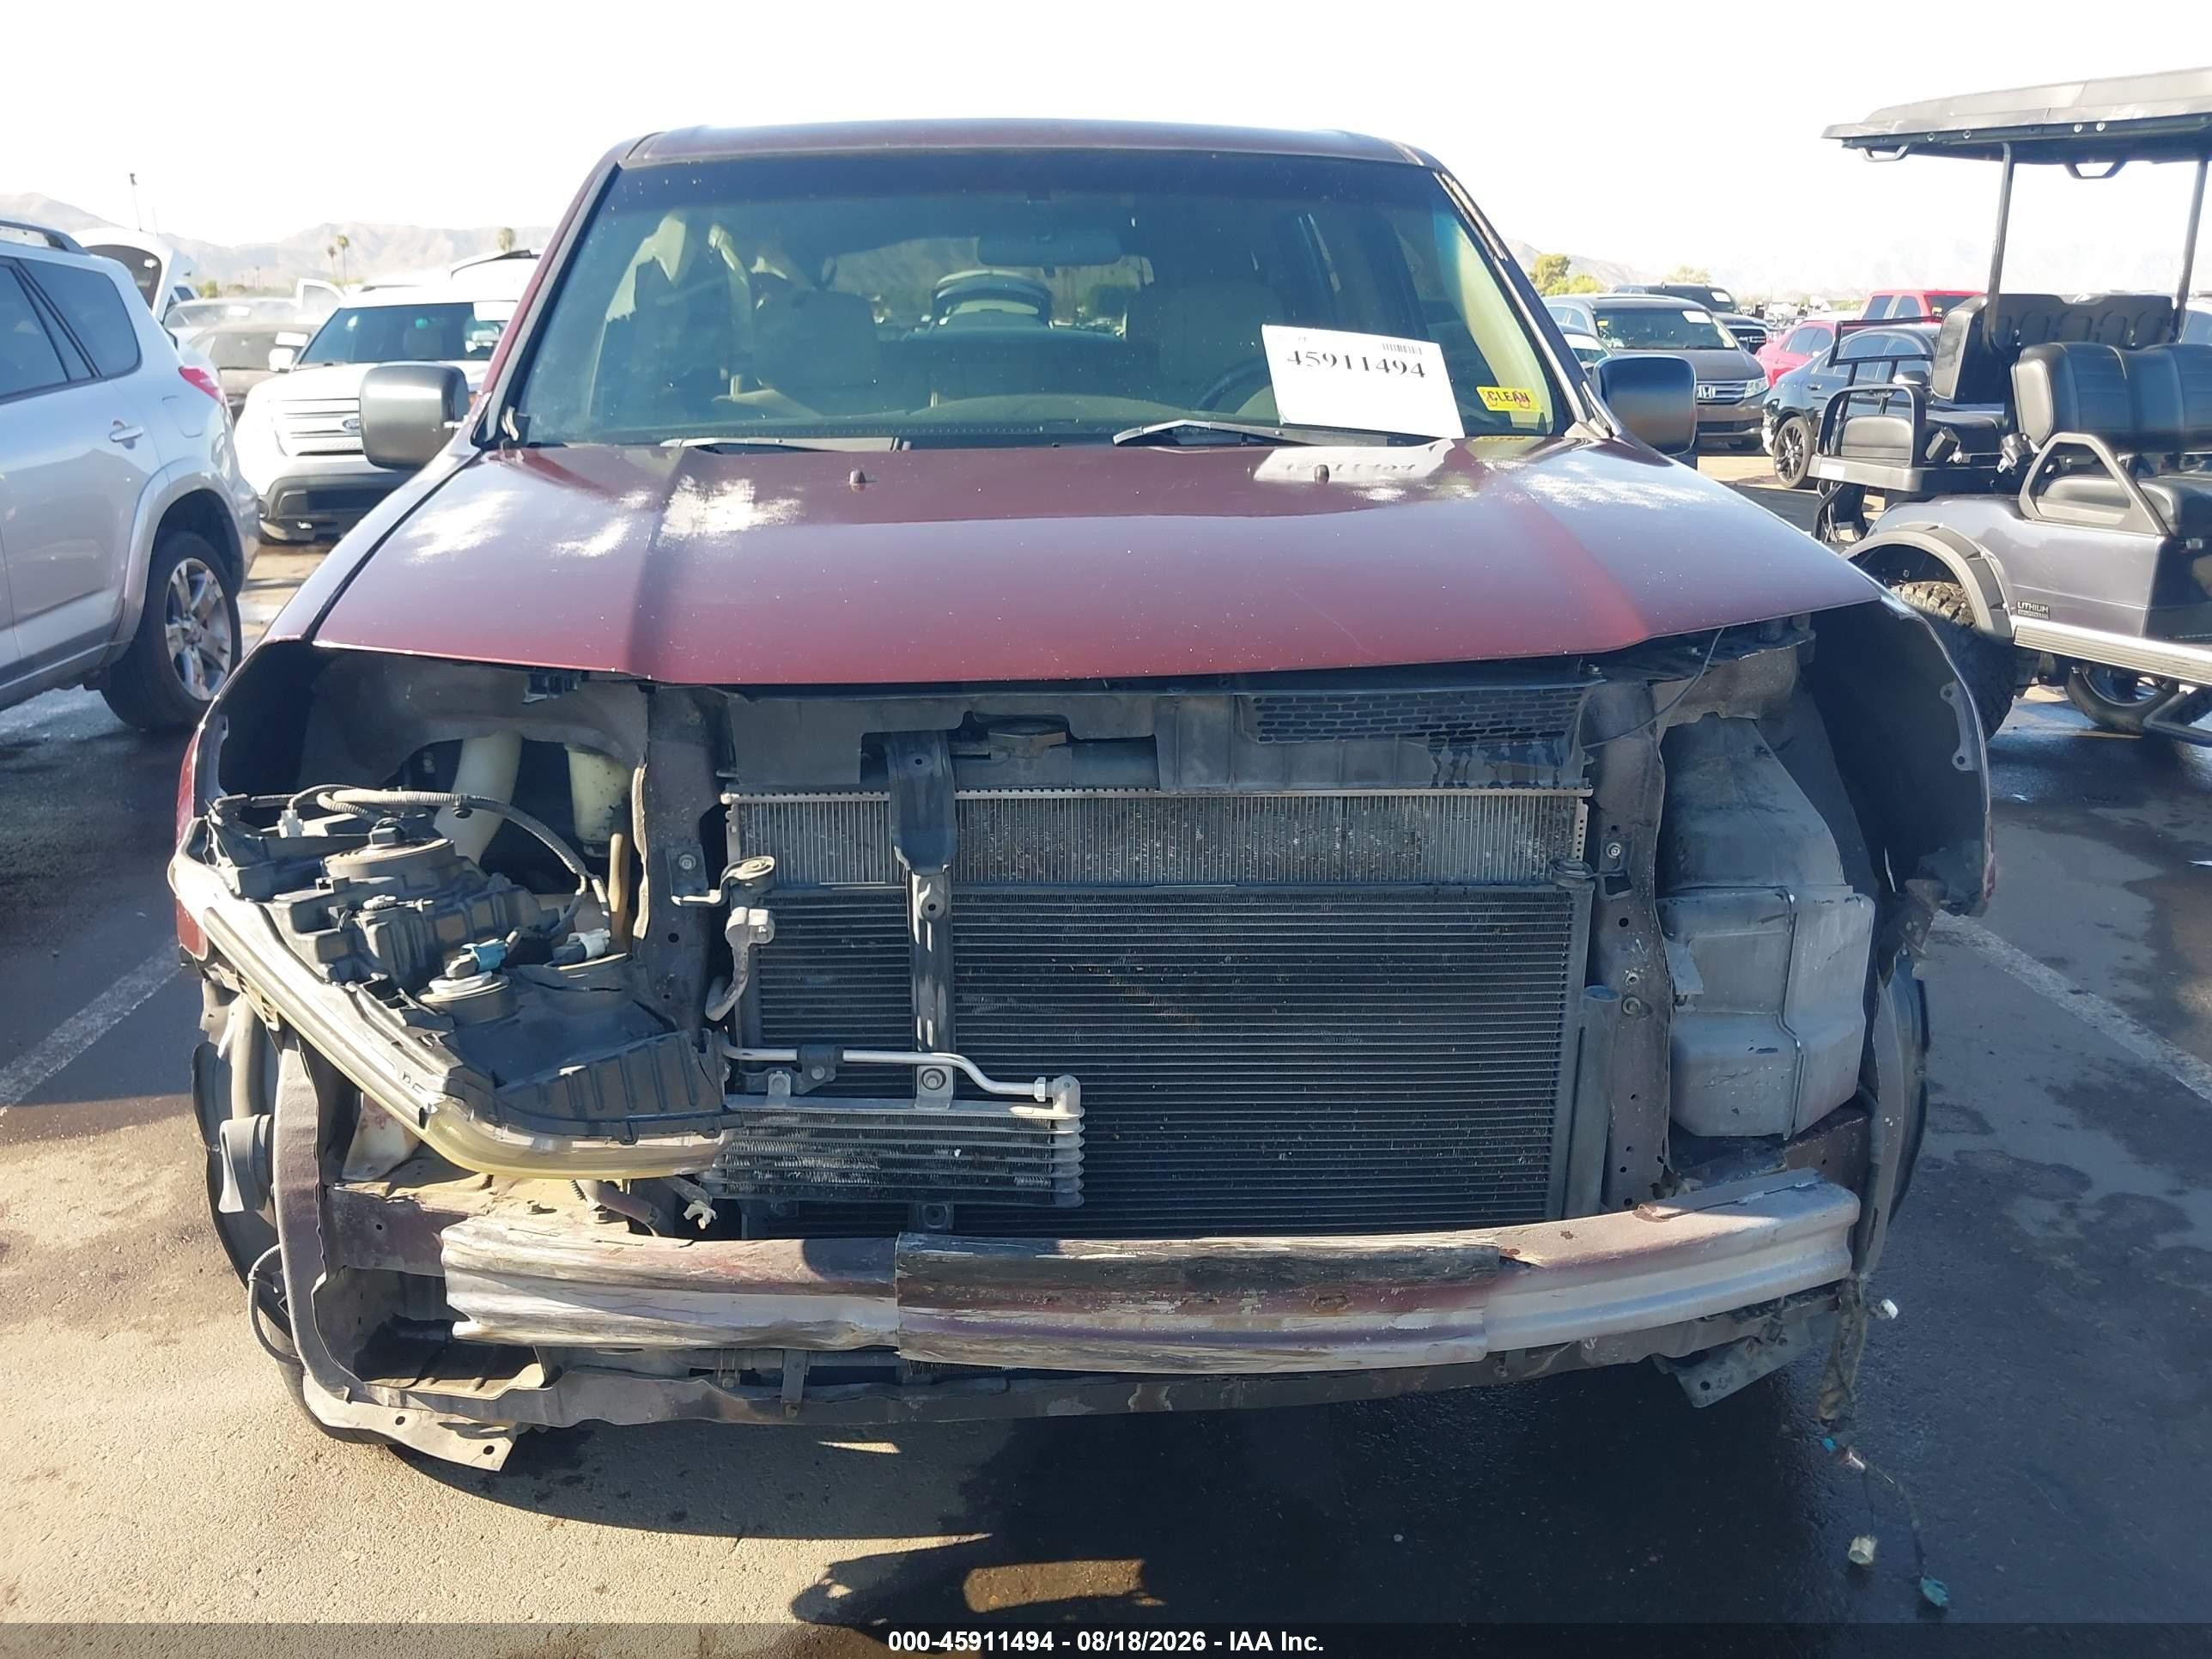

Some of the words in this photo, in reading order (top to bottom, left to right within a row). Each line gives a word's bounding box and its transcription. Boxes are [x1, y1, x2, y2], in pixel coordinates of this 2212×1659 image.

[1286, 349, 1426, 378] 45911494
[1486, 390, 1531, 404] CLEAN
[2017, 601, 2049, 613] LITHIUM
